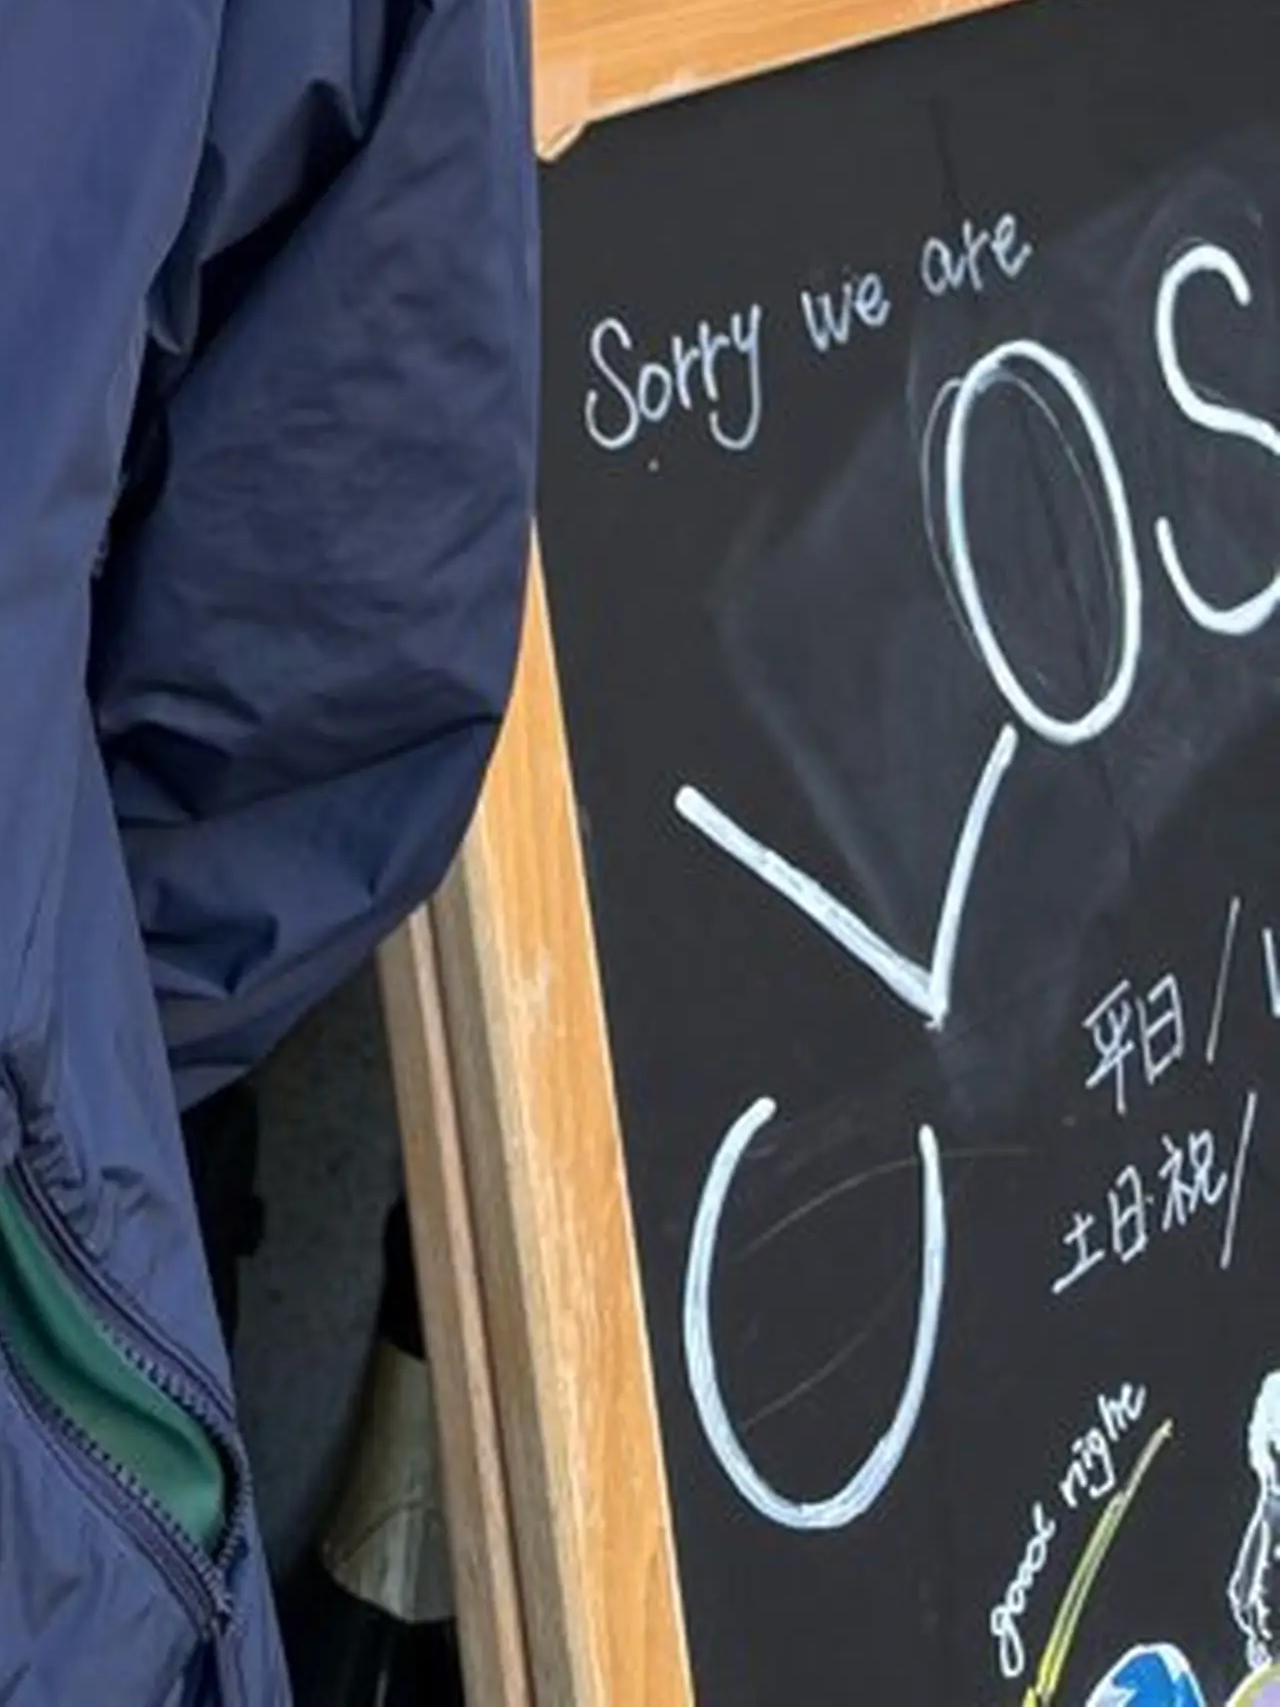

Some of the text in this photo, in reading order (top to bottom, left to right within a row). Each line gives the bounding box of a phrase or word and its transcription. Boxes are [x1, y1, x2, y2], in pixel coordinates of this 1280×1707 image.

[584, 212, 1034, 450] Sorry we are
[990, 1382, 1148, 1679] good night
